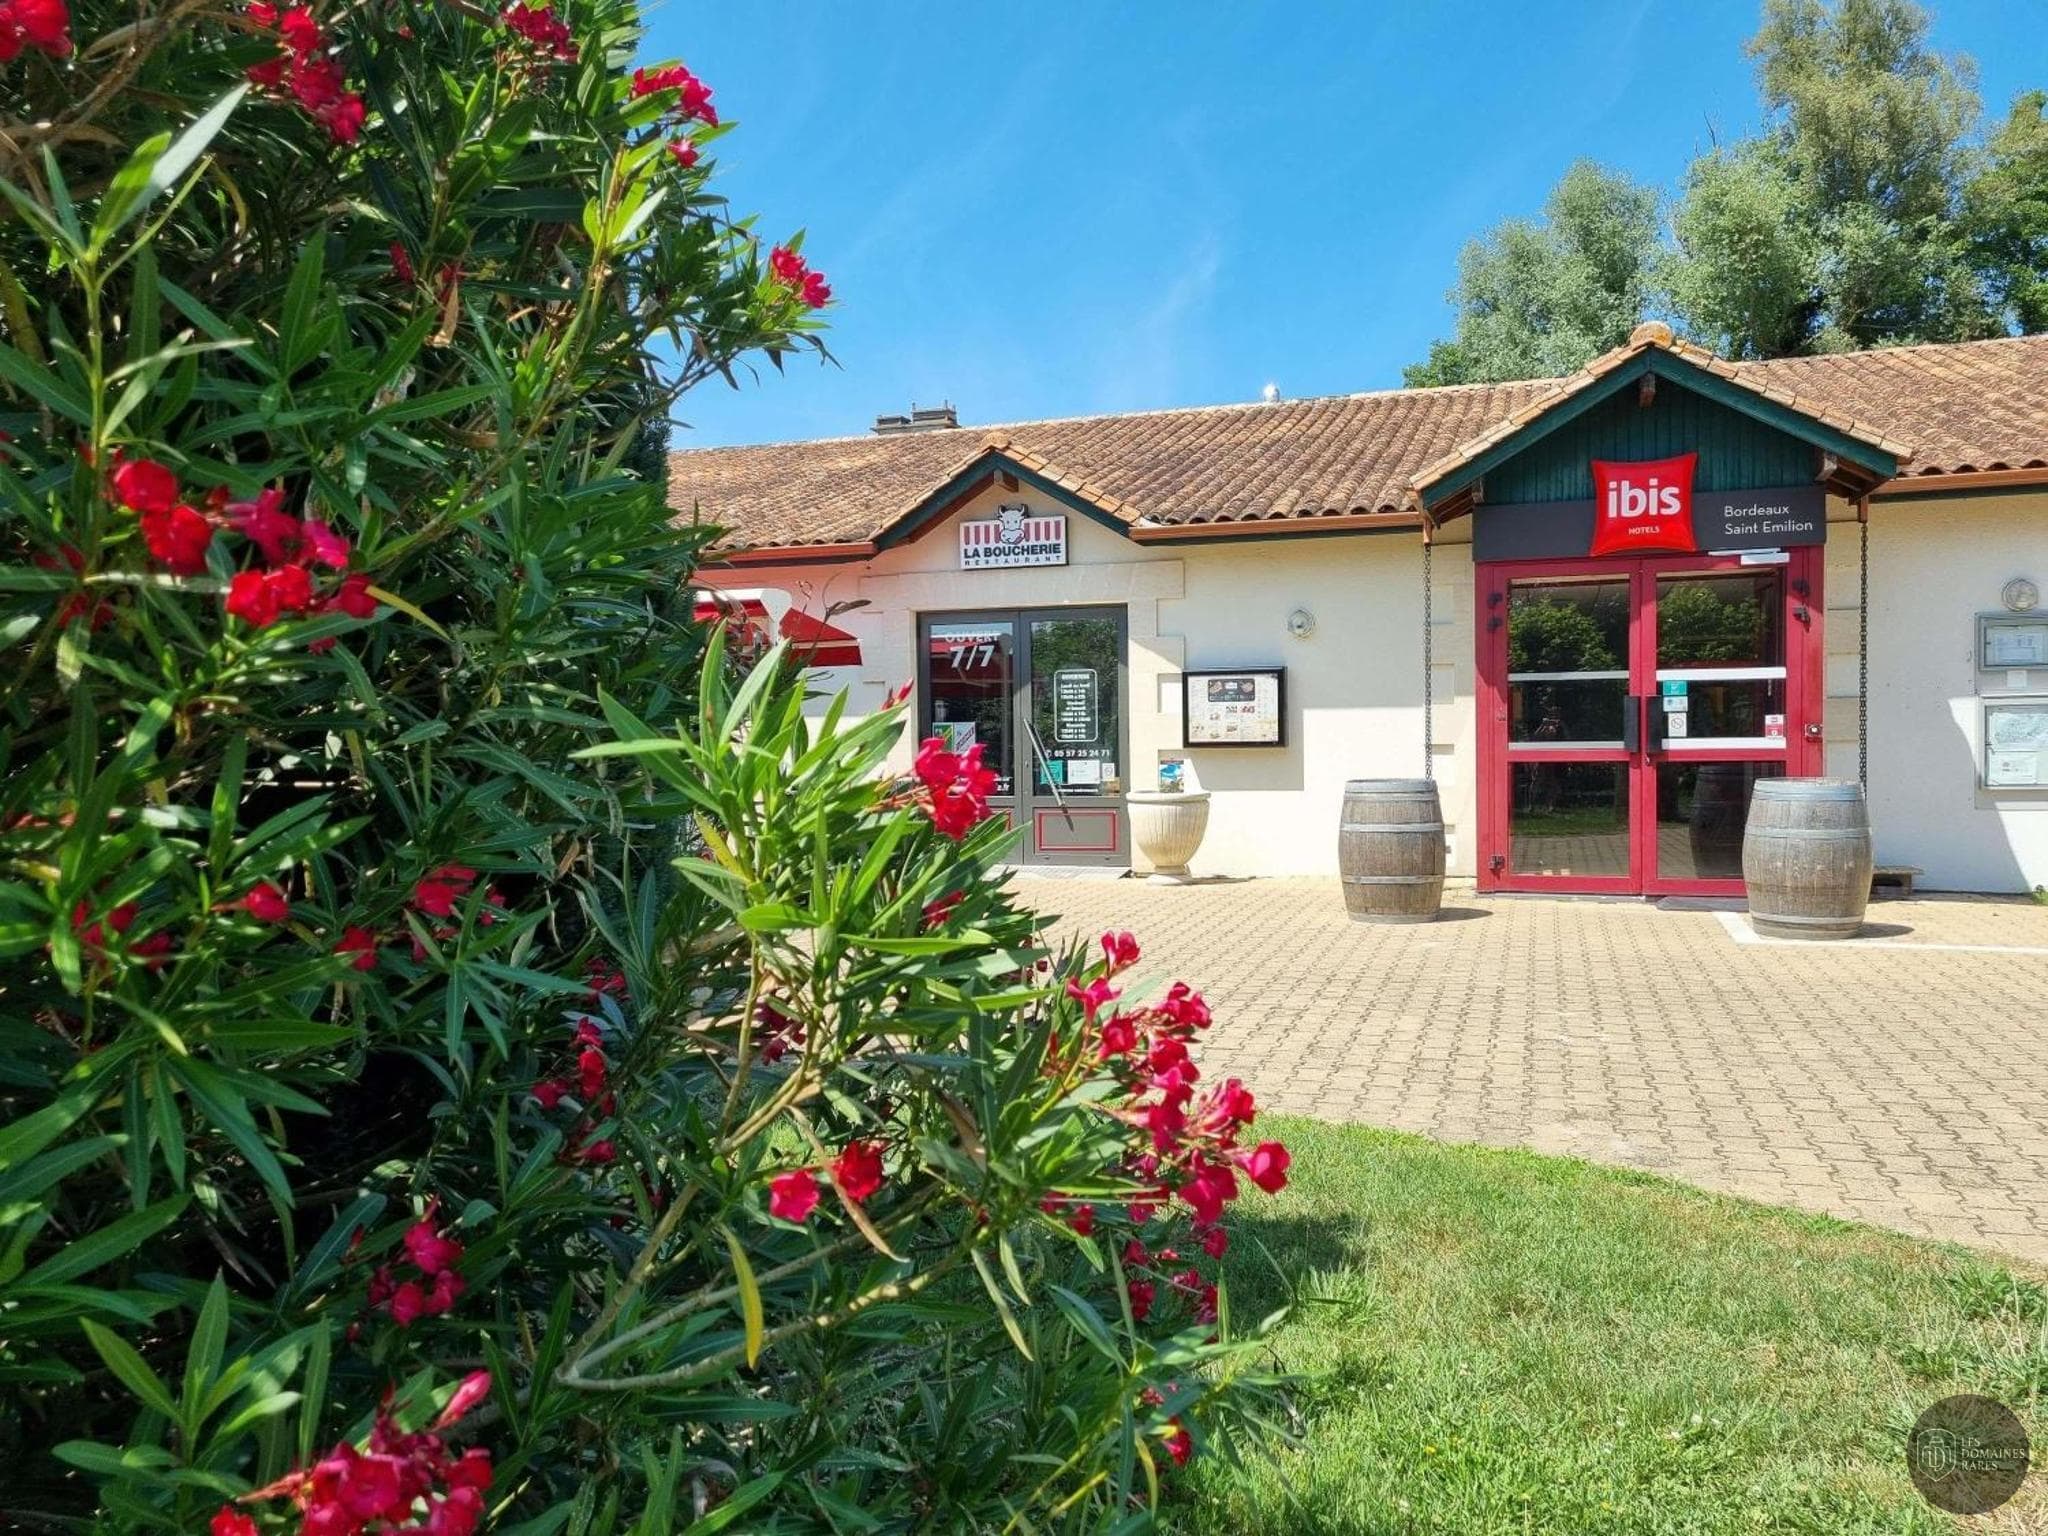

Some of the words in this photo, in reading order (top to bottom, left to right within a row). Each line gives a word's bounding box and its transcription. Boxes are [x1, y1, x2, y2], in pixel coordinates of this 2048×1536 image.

[1608, 478, 1681, 518] ibis
[1724, 504, 1790, 517] Bordeaux
[1628, 525, 1660, 536] HOTELS
[1724, 523, 1759, 536] Saint
[1762, 520, 1813, 533] Emilion
[963, 548, 981, 559] LA
[983, 543, 1062, 558] BOUCHERIE
[964, 555, 1062, 567] RESTAURANT
[949, 645, 995, 671] 7/7
[1077, 749, 1087, 758] 25
[1088, 749, 1099, 758] 24
